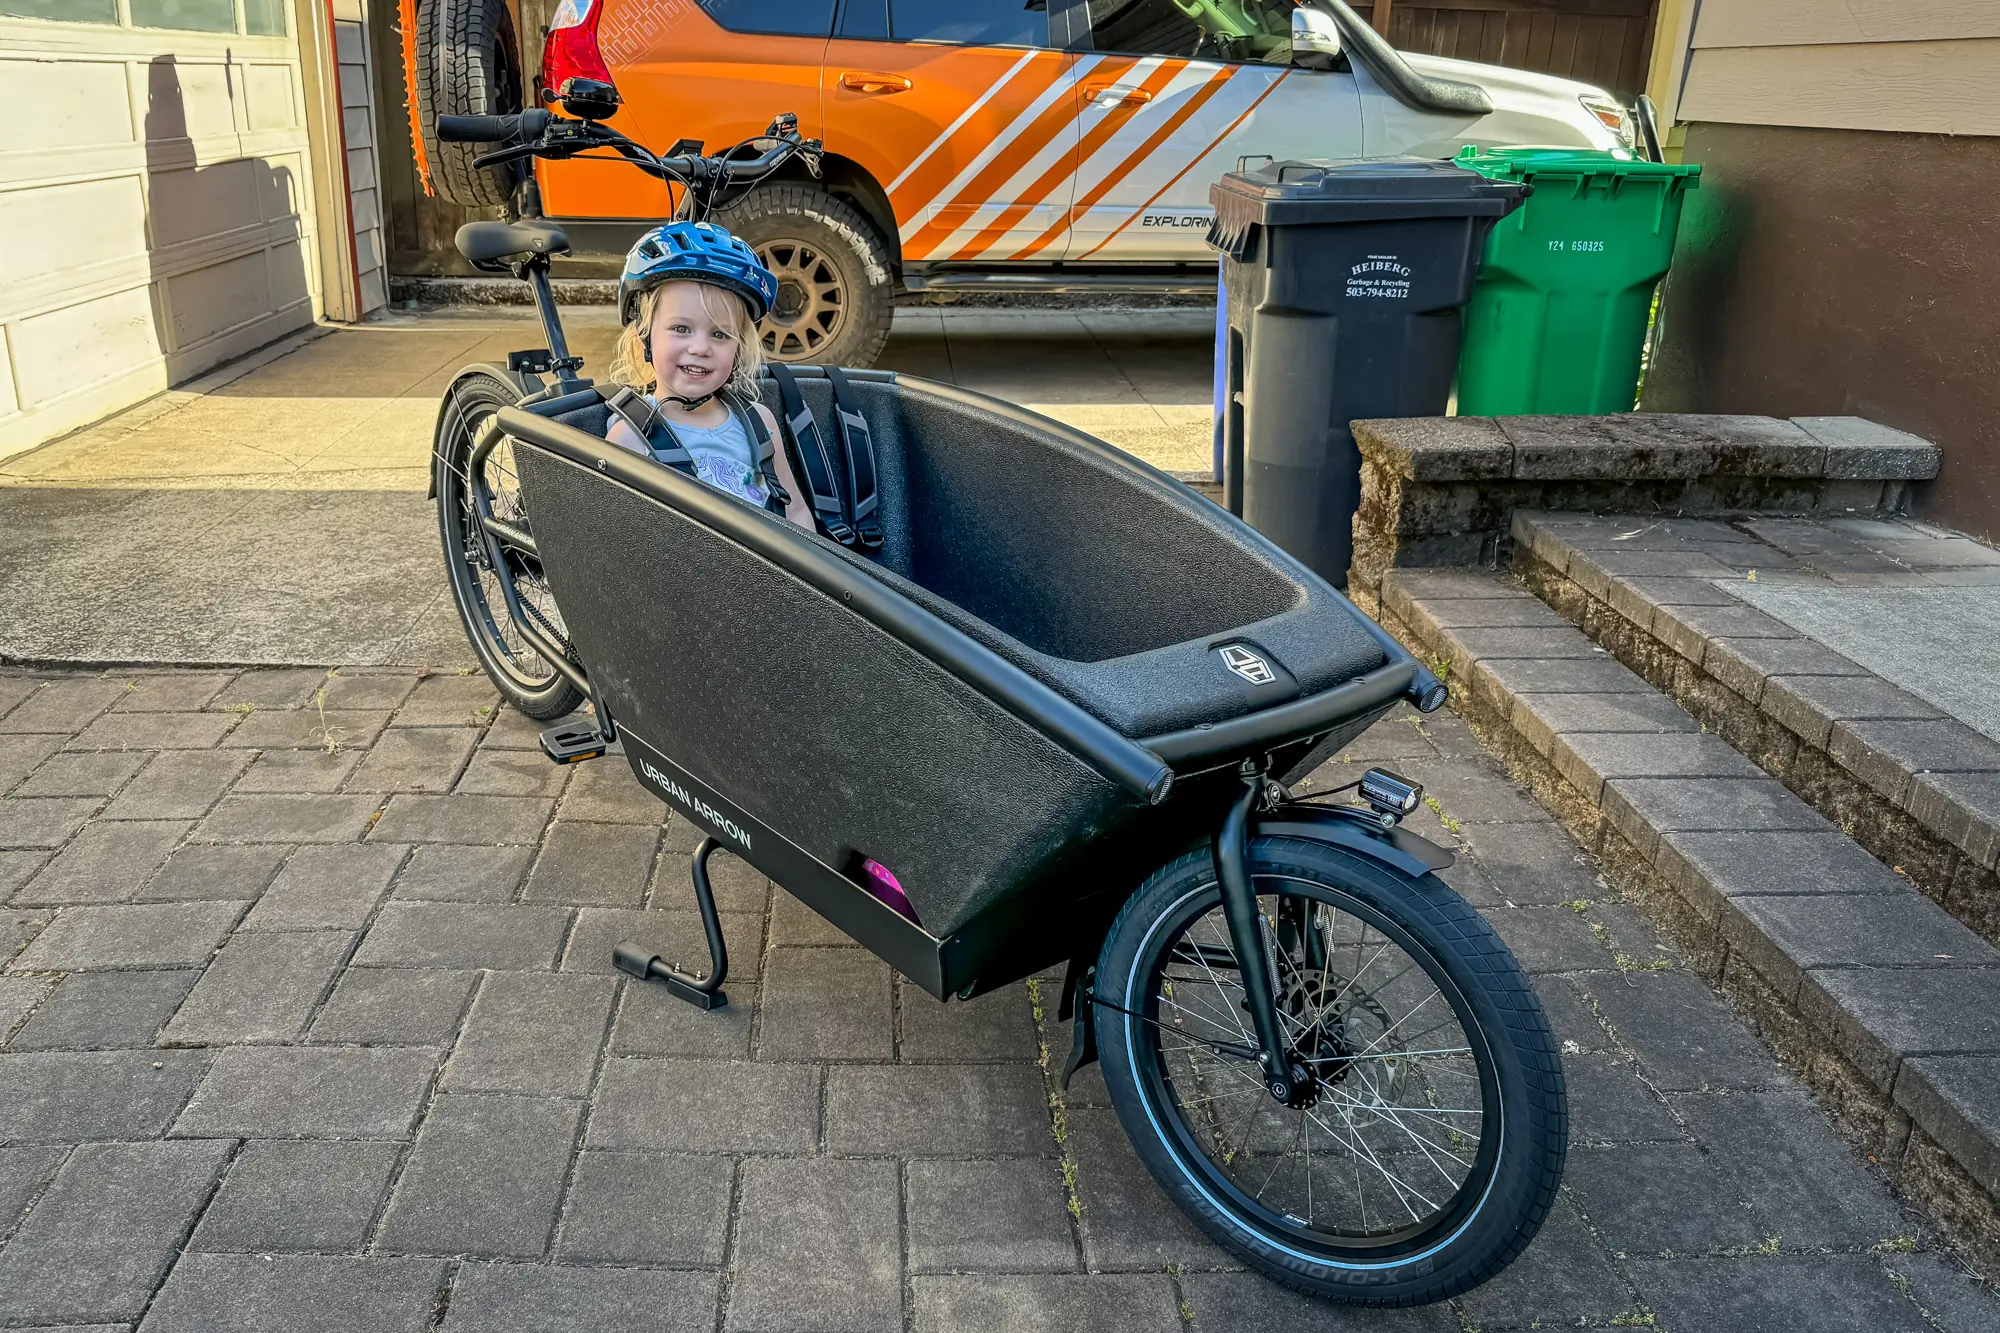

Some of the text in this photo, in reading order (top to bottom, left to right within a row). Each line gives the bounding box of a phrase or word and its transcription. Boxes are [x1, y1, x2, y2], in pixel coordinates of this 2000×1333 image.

[1548, 240, 1604, 252] Y24 650325
[1351, 261, 1411, 277] HEIBERG
[1346, 278, 1373, 287] Garbage
[1381, 279, 1410, 288] Recycling
[1345, 287, 1409, 298] 503-794-8212
[639, 758, 752, 850] URBAN ARROW
